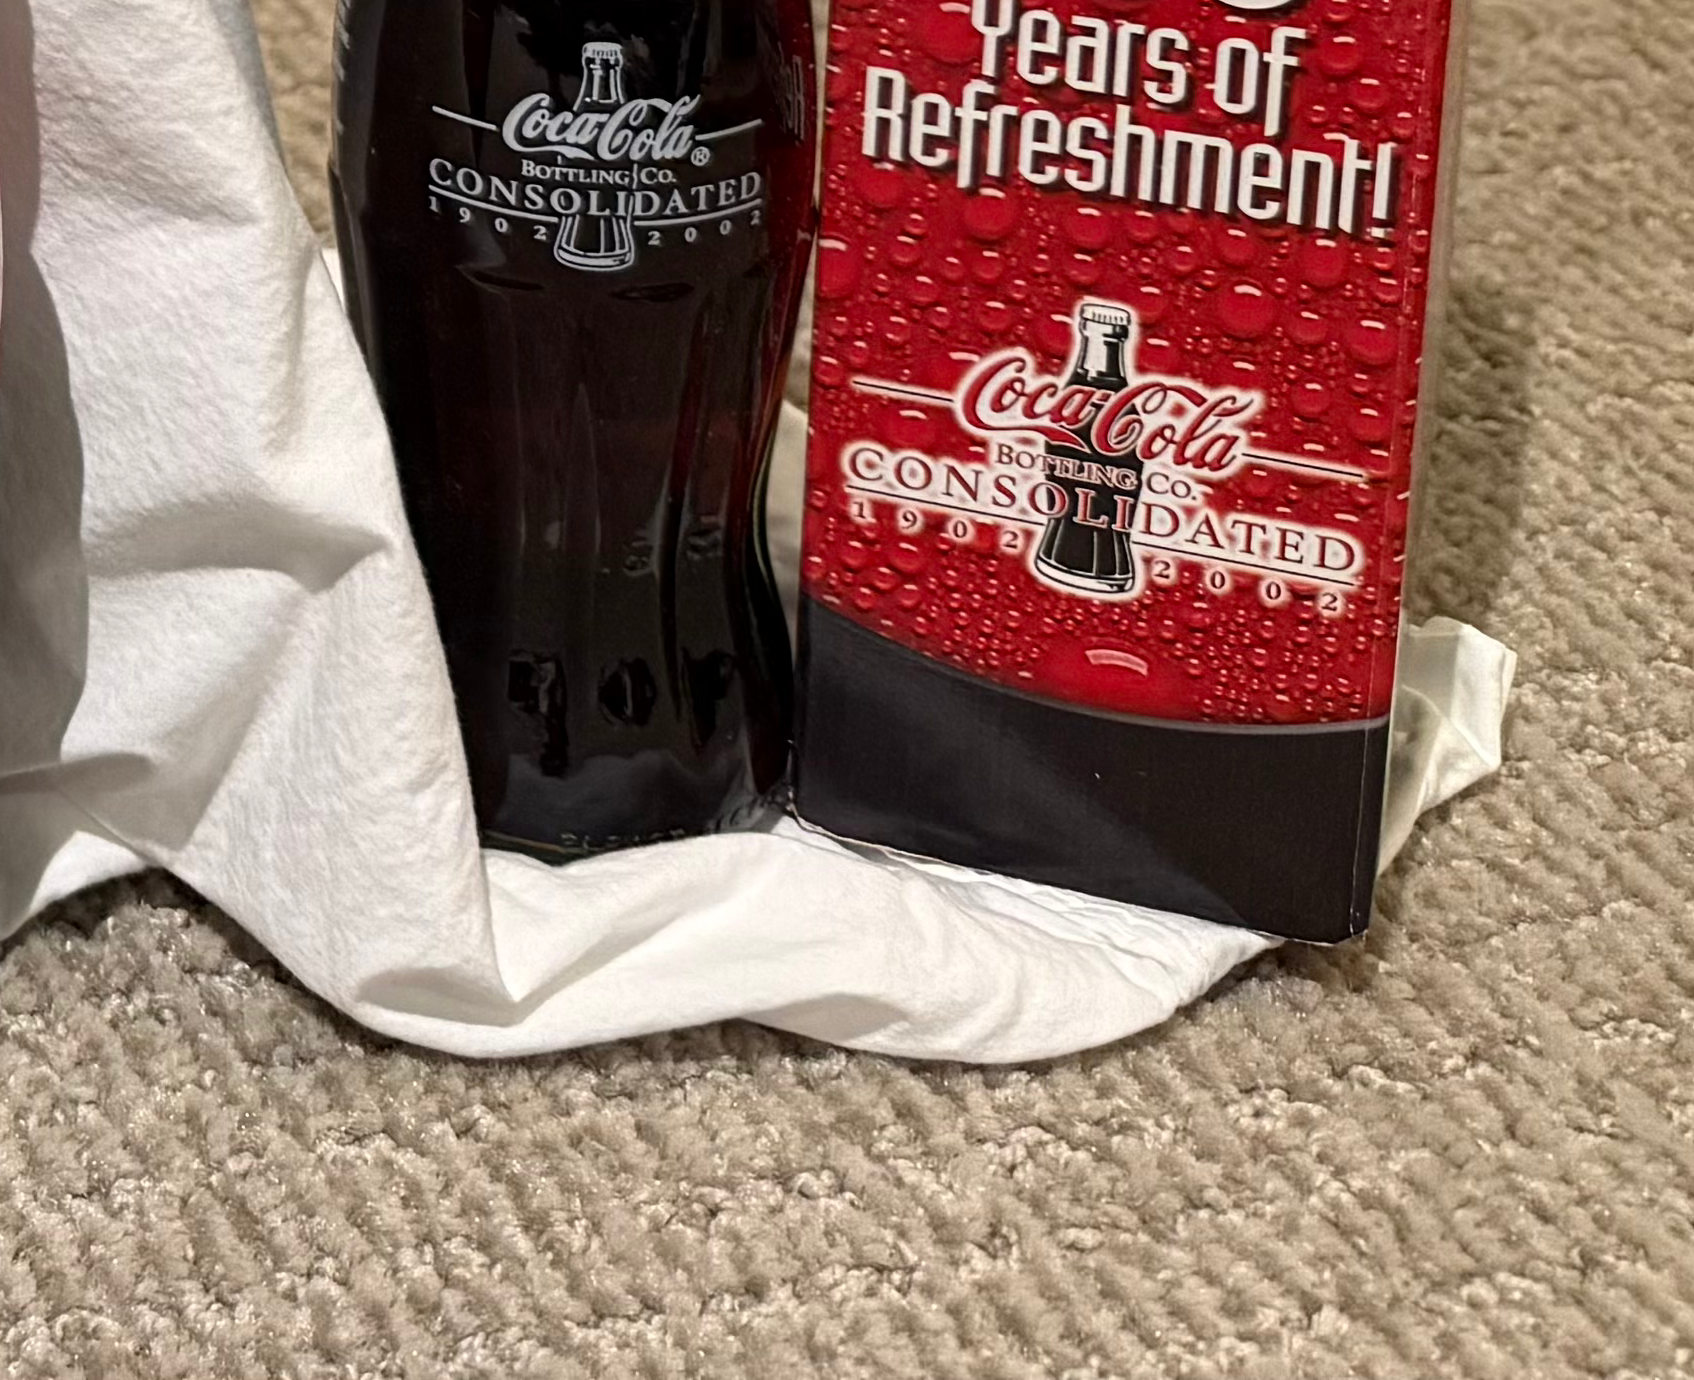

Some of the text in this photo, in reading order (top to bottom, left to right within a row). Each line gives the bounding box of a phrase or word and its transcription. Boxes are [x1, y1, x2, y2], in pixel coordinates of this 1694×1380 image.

[502, 92, 702, 162] Coca-Cola
[1213, 25, 1308, 138] of
[428, 157, 764, 218] CONSOLIDATED
[521, 158, 631, 186] BOTTLING
[861, 65, 1399, 238] Refreshment!
[960, 354, 1256, 474] Coca-Cola
[848, 446, 1357, 573] CONSOLIDATED
[995, 443, 1139, 490] BOTTLING
